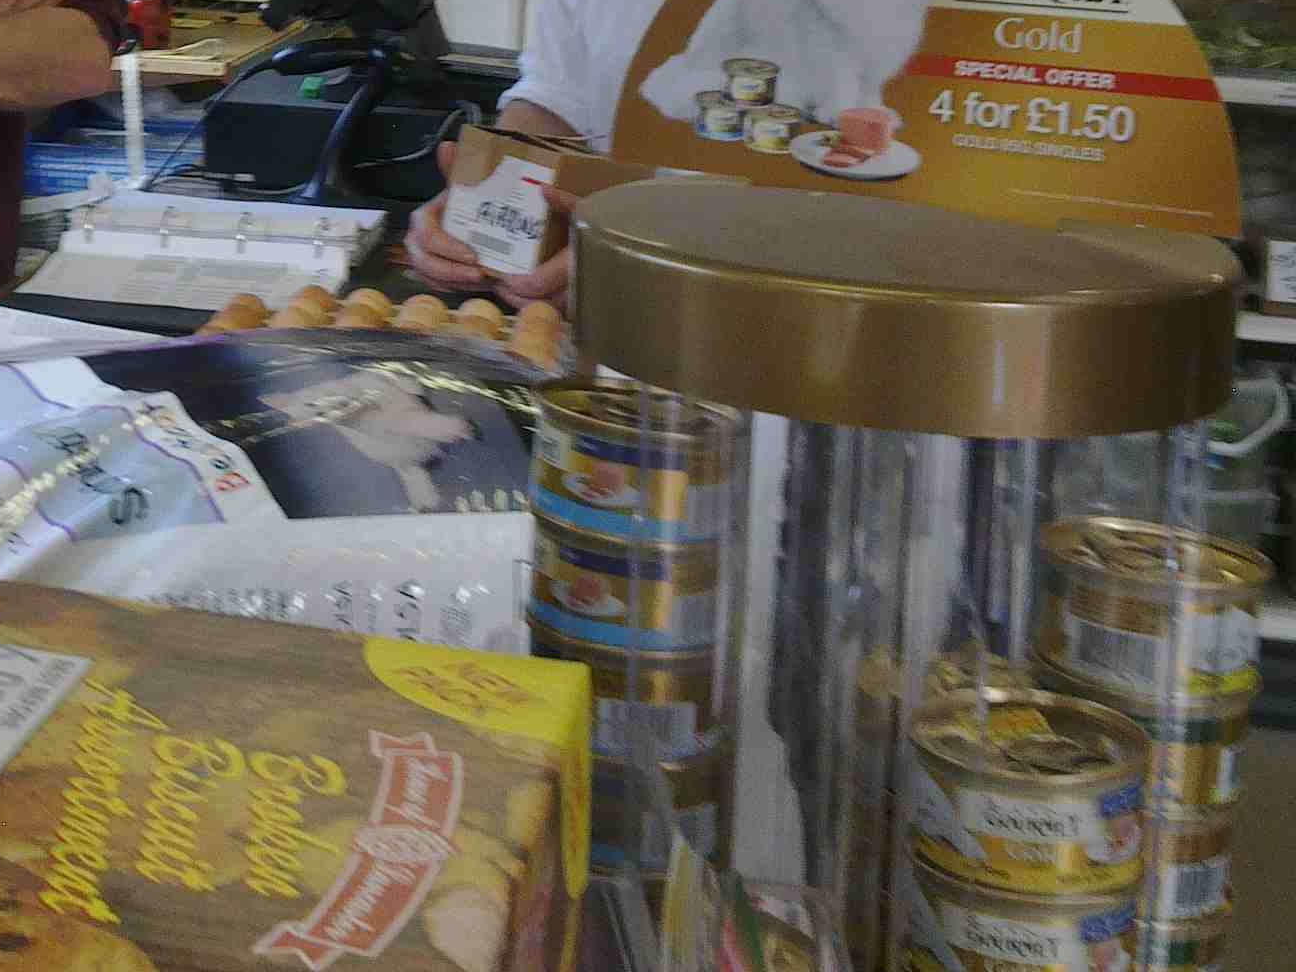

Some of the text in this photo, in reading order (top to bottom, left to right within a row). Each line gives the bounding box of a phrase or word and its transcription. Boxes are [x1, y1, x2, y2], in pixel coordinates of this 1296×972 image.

[993, 16, 1084, 54] Gold
[954, 60, 1117, 90] SPECIAL OFFER
[927, 89, 1137, 144] 4 for £1.50
[39, 677, 170, 927] Assortment
[134, 734, 247, 895] Biscuit
